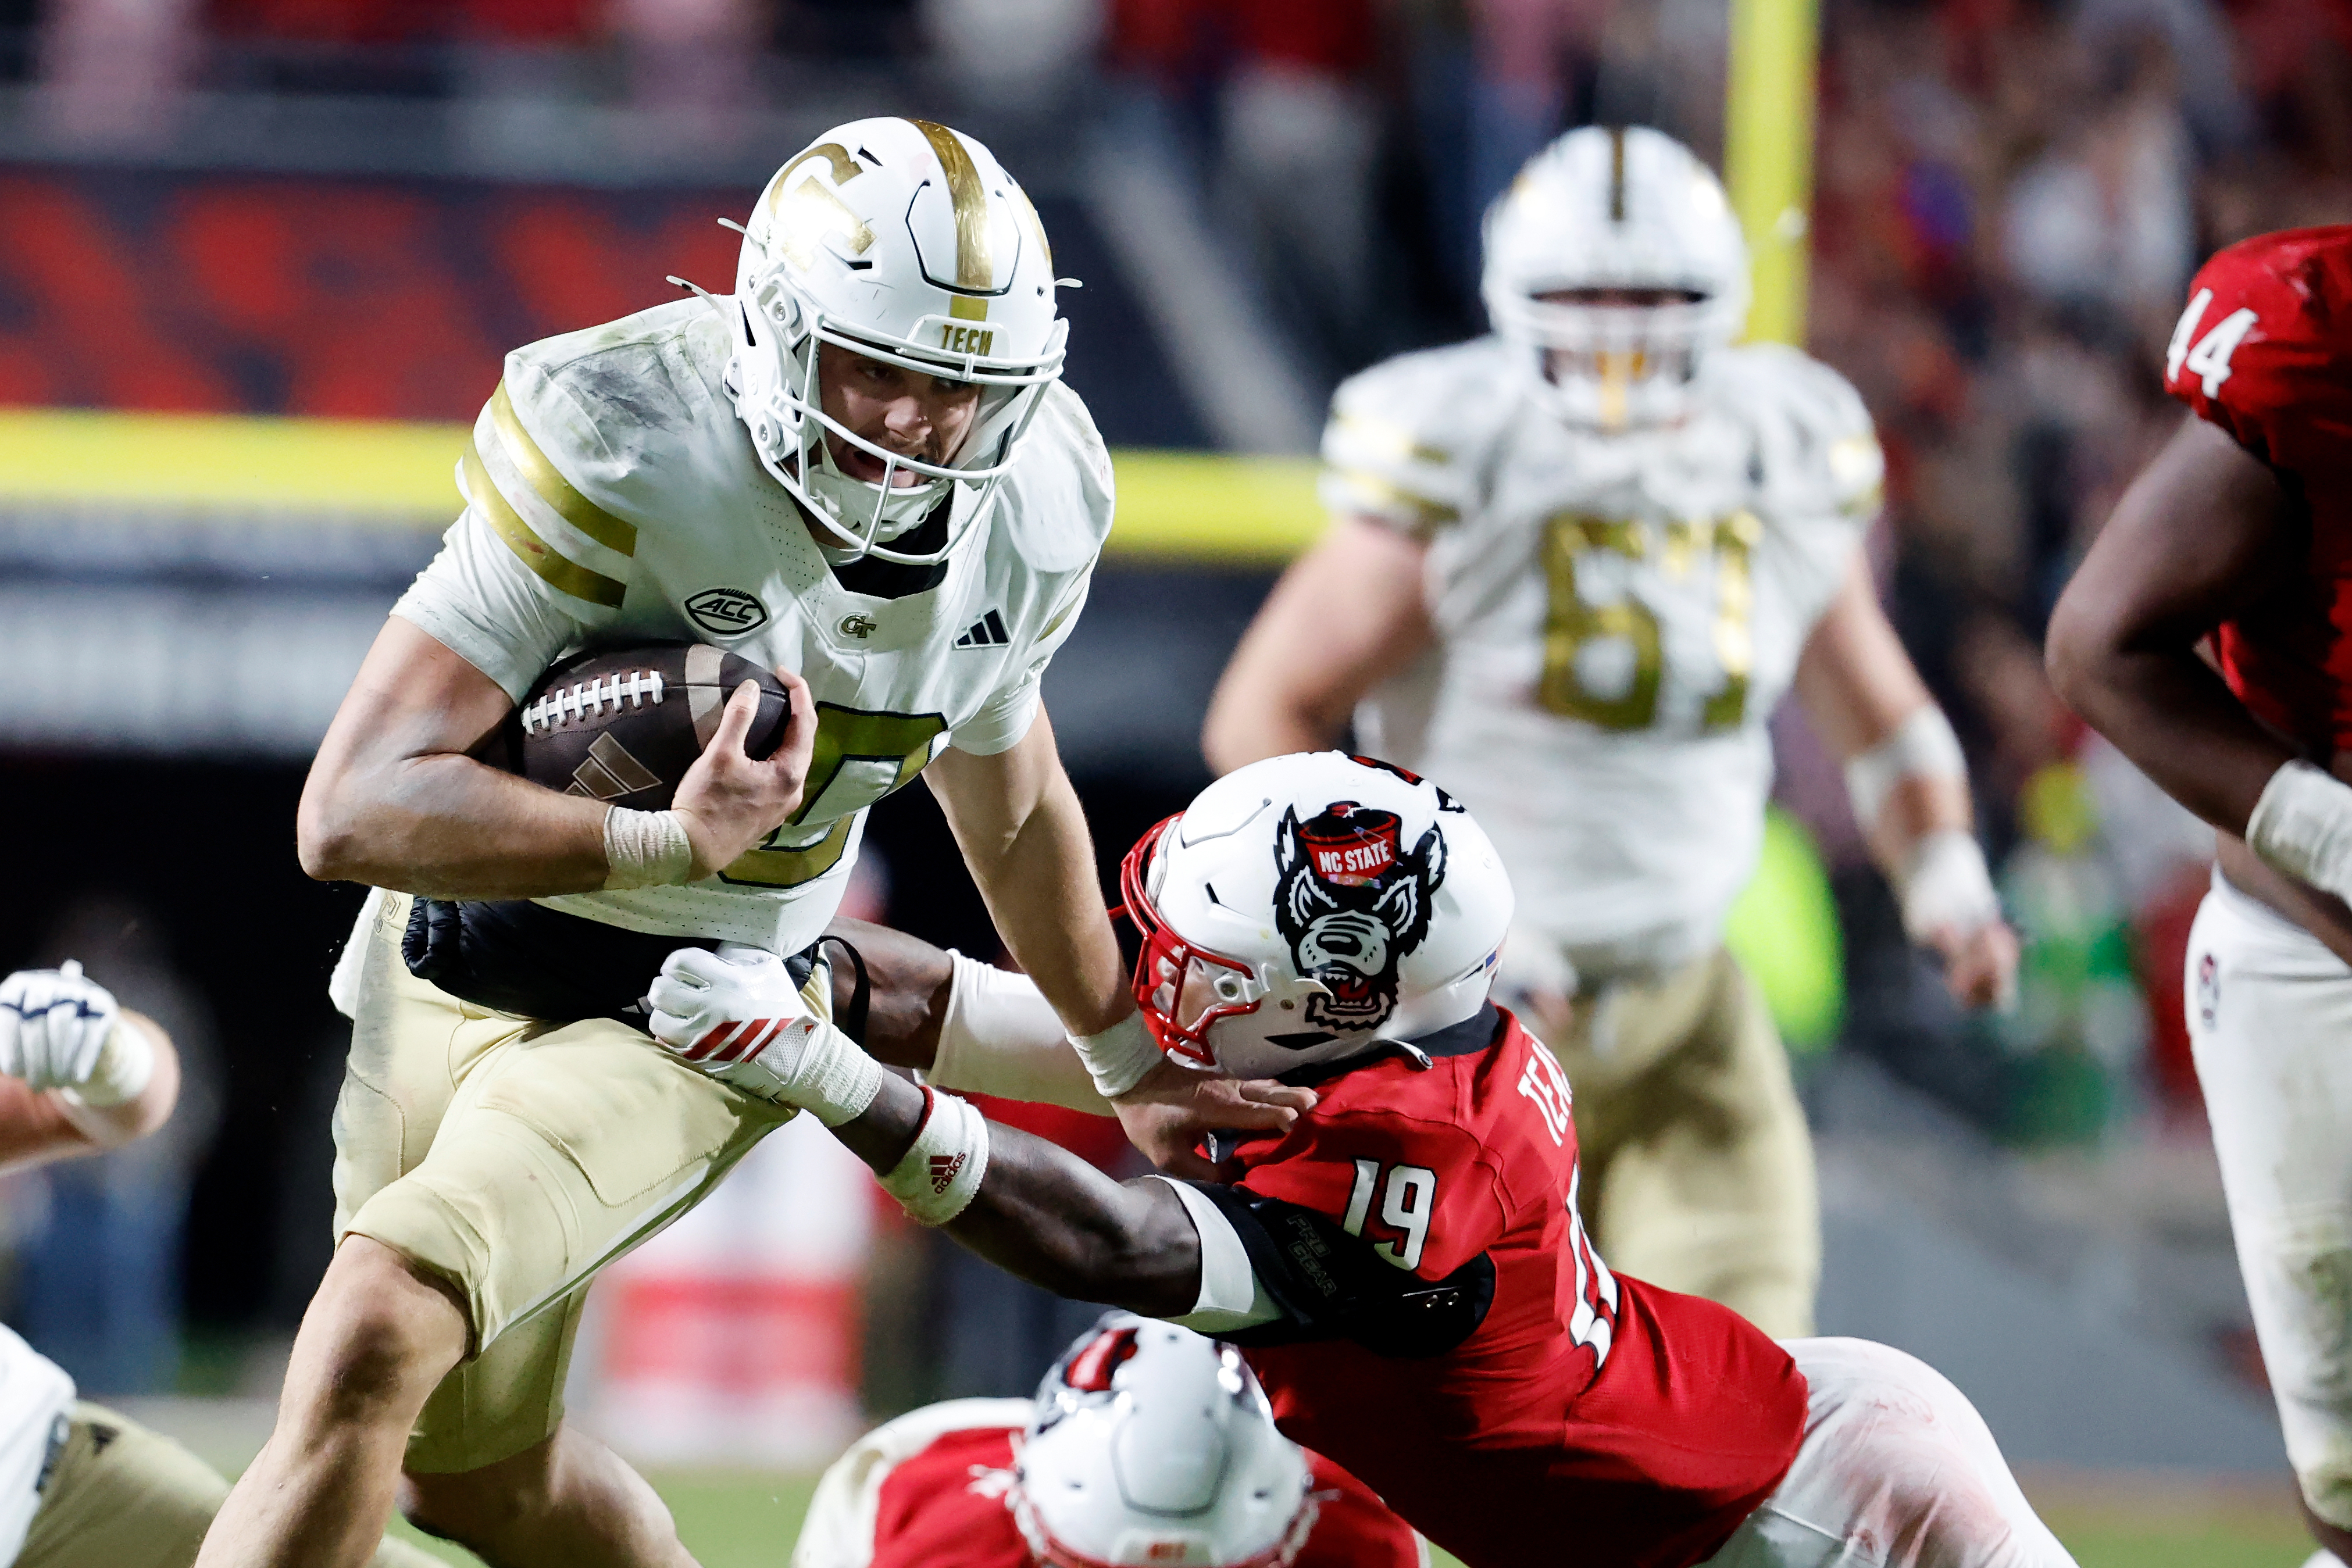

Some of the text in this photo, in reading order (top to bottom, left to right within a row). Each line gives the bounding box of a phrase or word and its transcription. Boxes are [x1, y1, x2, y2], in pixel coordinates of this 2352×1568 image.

[941, 324, 993, 356] TECH
[697, 598, 758, 620] ACC
[1319, 841, 1391, 873] NC STATE
[934, 1152, 966, 1194] adidas
[1343, 1159, 1437, 1271] 19
